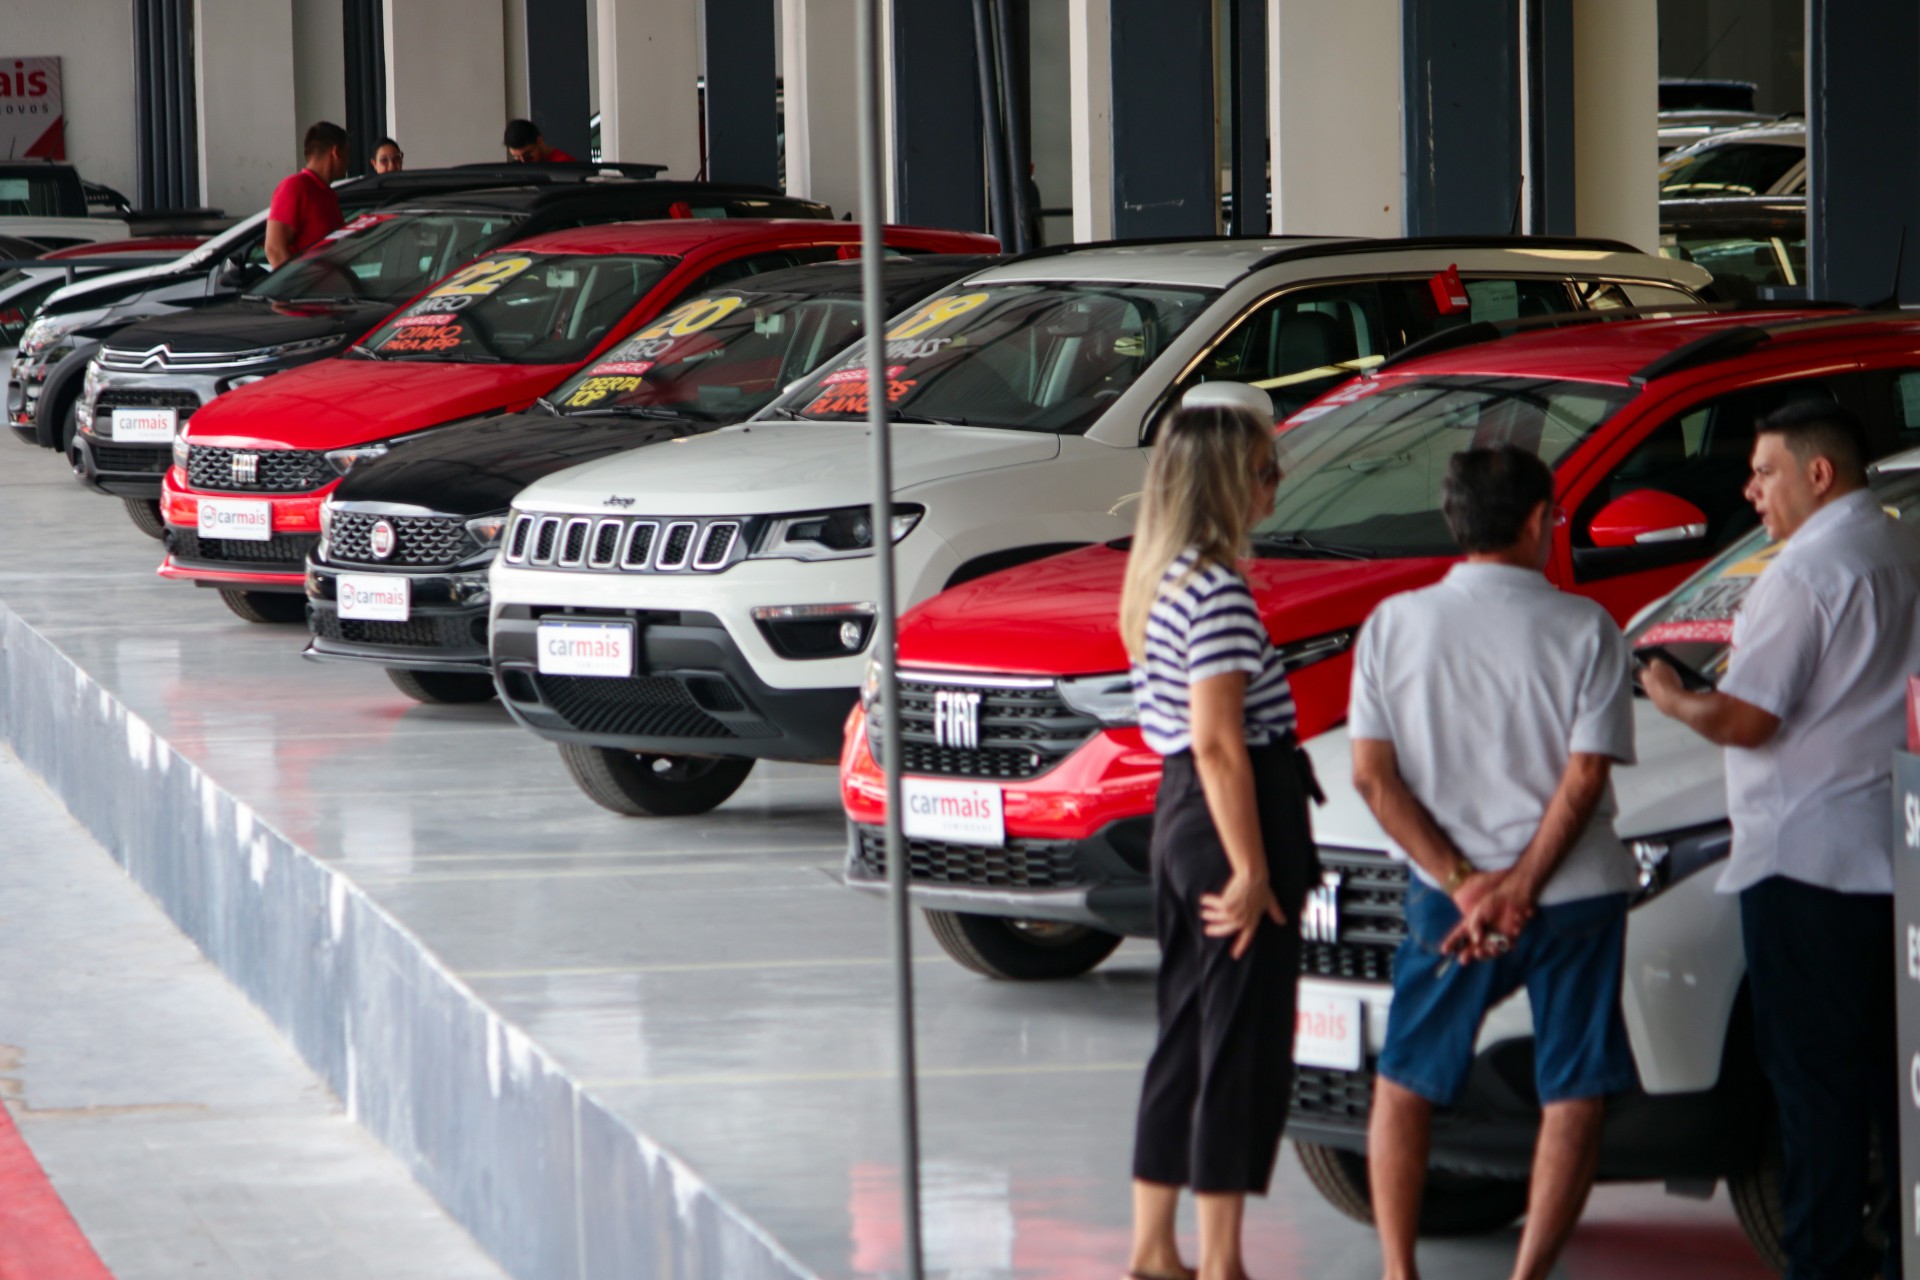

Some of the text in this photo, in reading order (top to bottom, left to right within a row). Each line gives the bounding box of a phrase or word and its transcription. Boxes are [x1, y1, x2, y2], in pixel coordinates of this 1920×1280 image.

[0, 104, 49, 115] OVOS
[427, 257, 532, 298] 22
[414, 295, 473, 312] ARGO
[632, 296, 742, 341] 20
[884, 292, 990, 340] 19
[396, 325, 464, 340] OTIMO
[420, 338, 462, 351] APP
[613, 339, 674, 358] ARGO
[579, 376, 643, 392] OFERTA
[825, 379, 918, 398] OTIOS
[564, 389, 607, 407] TOP
[119, 413, 168, 430] carmais
[603, 495, 636, 509] Jeep
[217, 508, 266, 525] carmais
[356, 587, 404, 606] carmais
[548, 633, 620, 659] carmais
[934, 690, 982, 749] FIAT
[909, 789, 991, 819] carmais
[1907, 924, 1920, 981] E
